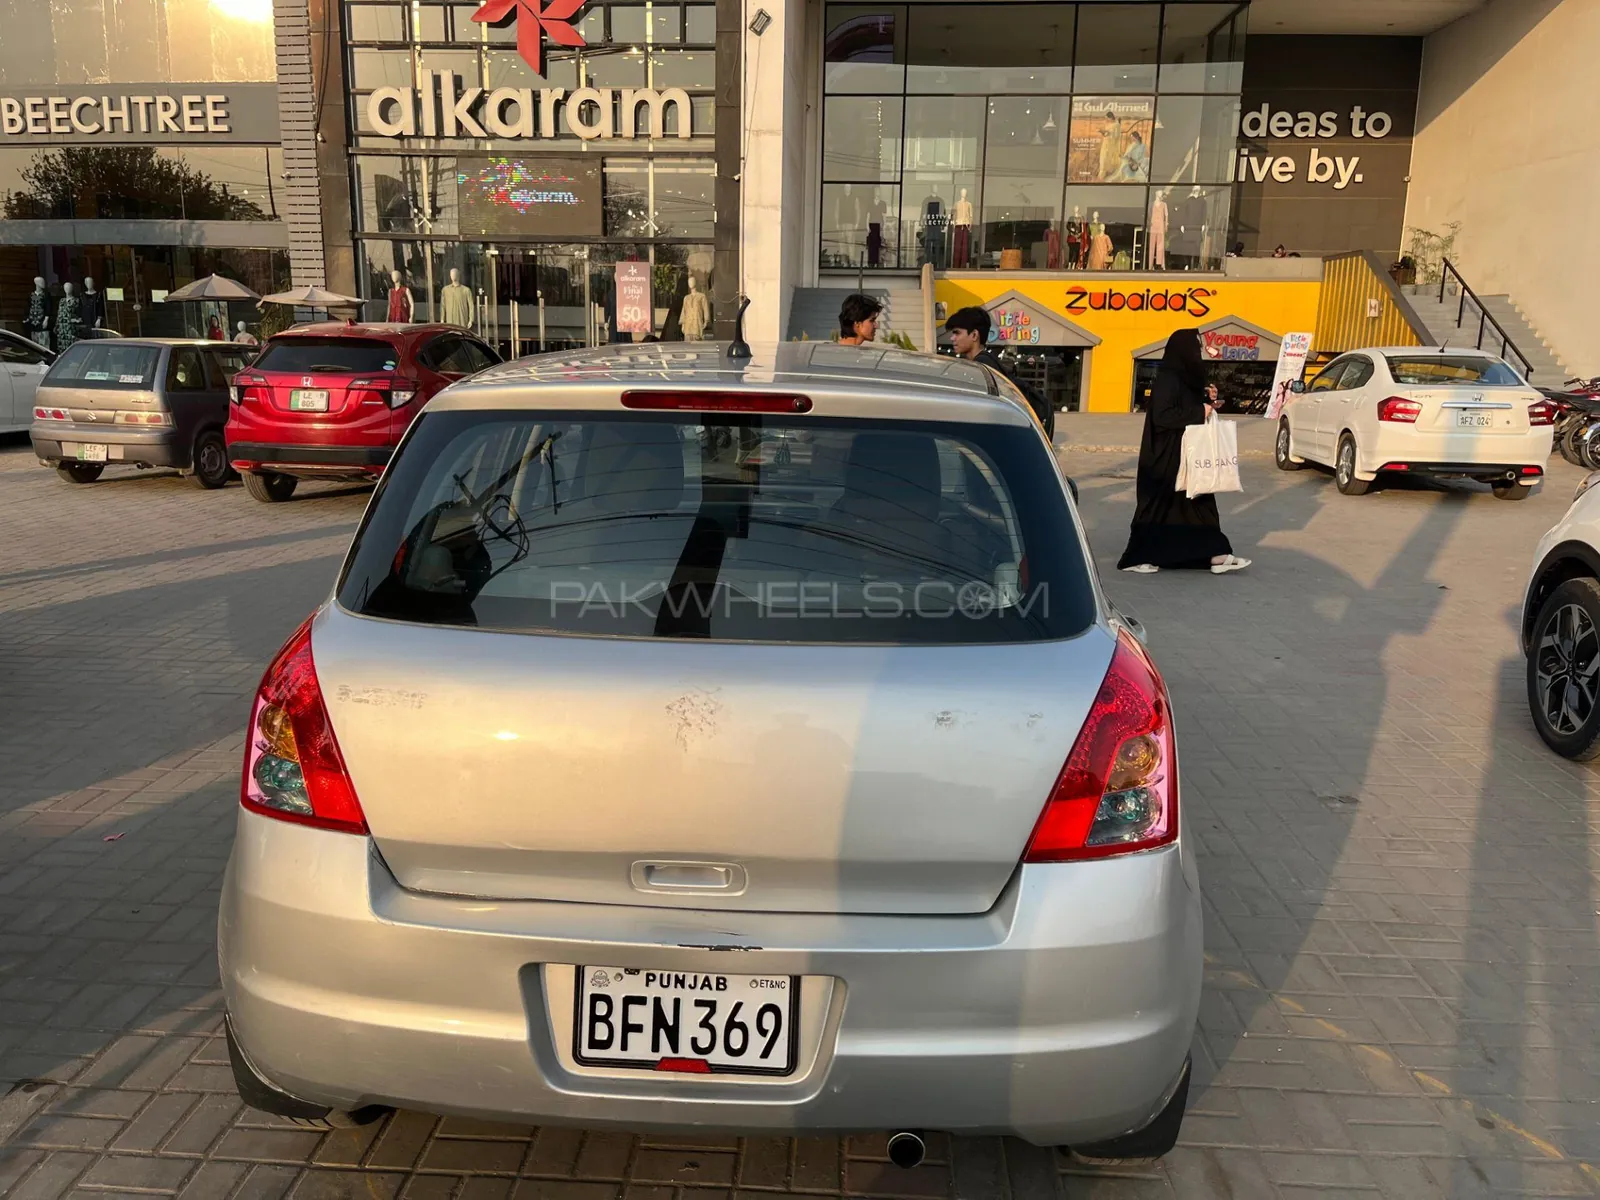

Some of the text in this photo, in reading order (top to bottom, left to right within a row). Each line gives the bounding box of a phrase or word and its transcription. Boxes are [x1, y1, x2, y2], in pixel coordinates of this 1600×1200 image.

[0, 95, 231, 134] BEECHTREE
[366, 69, 693, 138] alkaram
[1350, 105, 1392, 138] to
[1307, 148, 1364, 189] by.
[622, 306, 641, 323] 50
[1204, 331, 1260, 349] Young
[1221, 346, 1260, 361] Land
[645, 972, 786, 992] PUNJAB ET&NC
[588, 993, 782, 1060] BFN369
